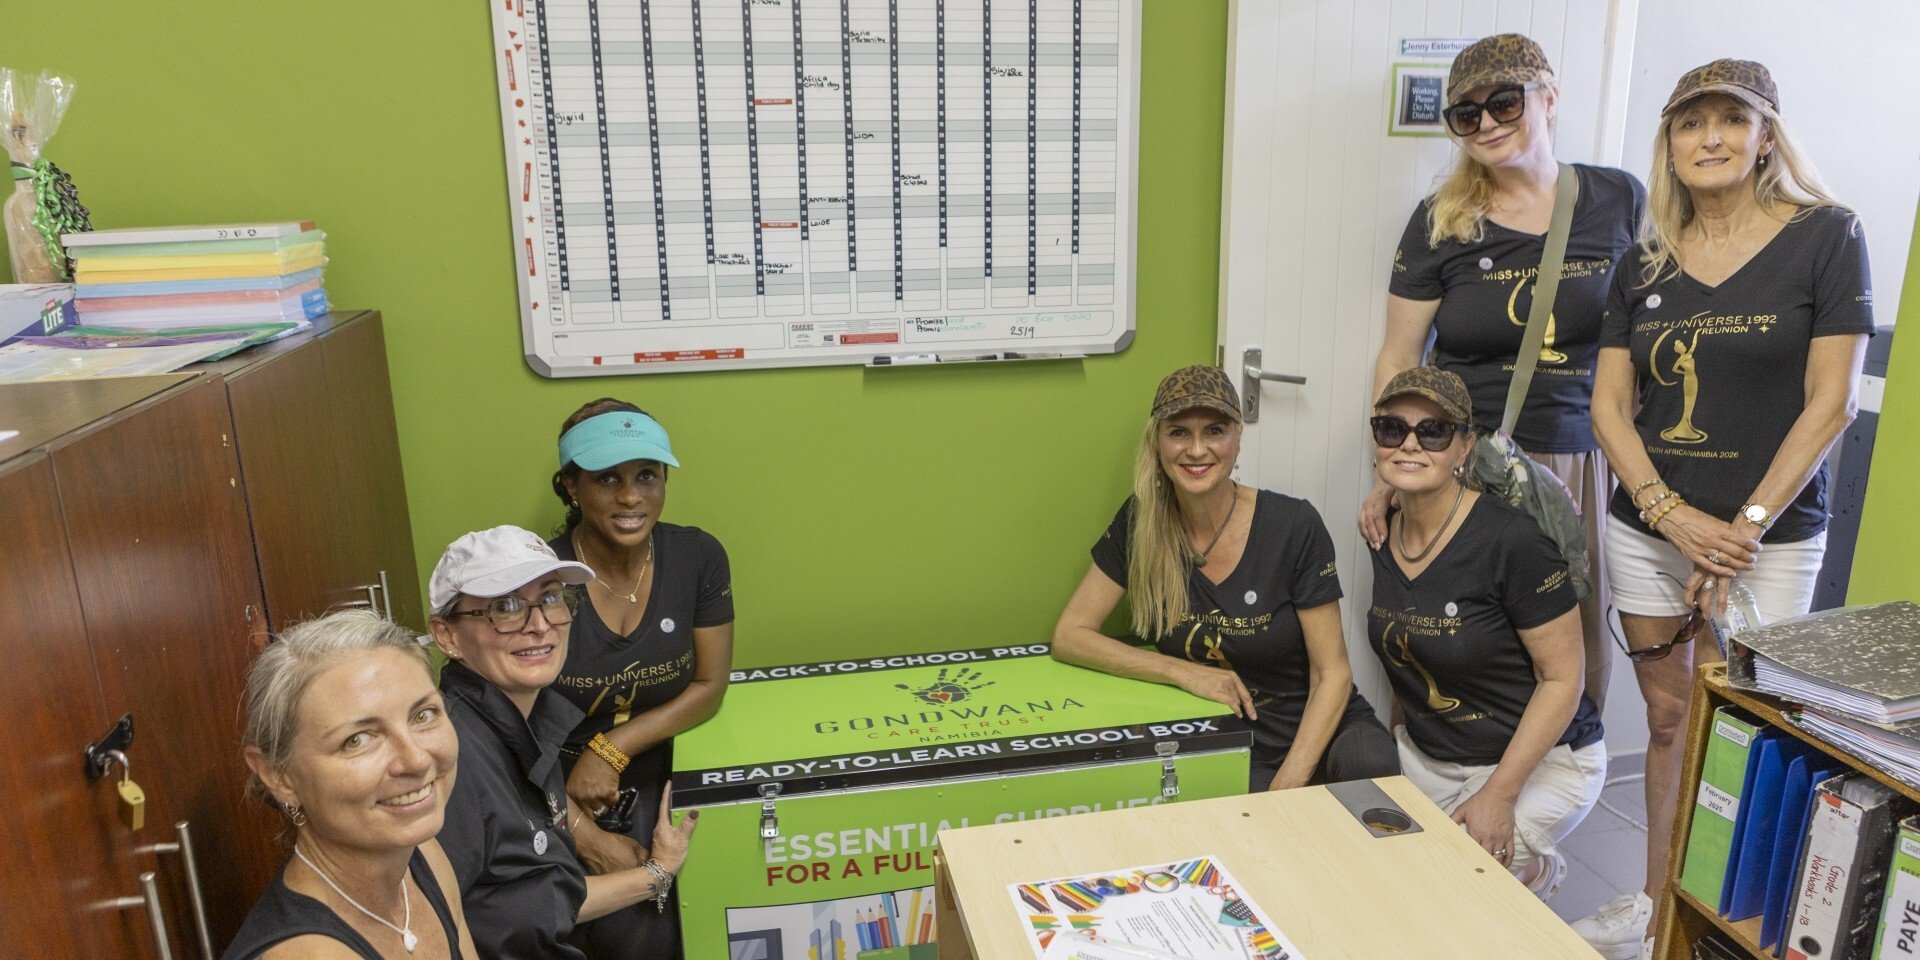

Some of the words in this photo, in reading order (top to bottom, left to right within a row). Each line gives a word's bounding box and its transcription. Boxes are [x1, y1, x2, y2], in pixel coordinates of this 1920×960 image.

[1407, 42, 1430, 51] Jenny
[555, 112, 585, 126] Sigrid
[1482, 268, 1513, 281] MISS
[43, 306, 64, 333] LITE
[1635, 320, 1660, 333] MISS
[1671, 314, 1745, 329] UNIVERSE
[1747, 314, 1777, 324] 1992
[1701, 325, 1749, 335] REUNION
[1197, 614, 1249, 628] UNIVERSE
[1250, 613, 1272, 627] 1992
[1438, 617, 1462, 628] 1992
[1220, 627, 1255, 636] REUNION
[558, 674, 593, 688] MISS
[605, 660, 674, 686] UNIVERSE
[730, 650, 986, 683] BACK-TO-SCHOOL
[639, 670, 680, 688] REUNION
[814, 697, 1086, 735] GONDWANA
[867, 726, 940, 740] CARE
[963, 715, 1047, 731] TRUST
[919, 728, 1003, 743] NAMIBIA
[702, 742, 1002, 786] READY-TO-LEARN
[1011, 726, 1145, 753] SCHOOL
[1152, 720, 1220, 738] BOX
[1705, 786, 1732, 805] February
[1708, 800, 1724, 814] 2025
[766, 862, 831, 887] FOR
[842, 858, 863, 879] A
[874, 850, 938, 875] FUL
[1822, 898, 1832, 906] 2
[1896, 899, 1920, 955] PAYE
